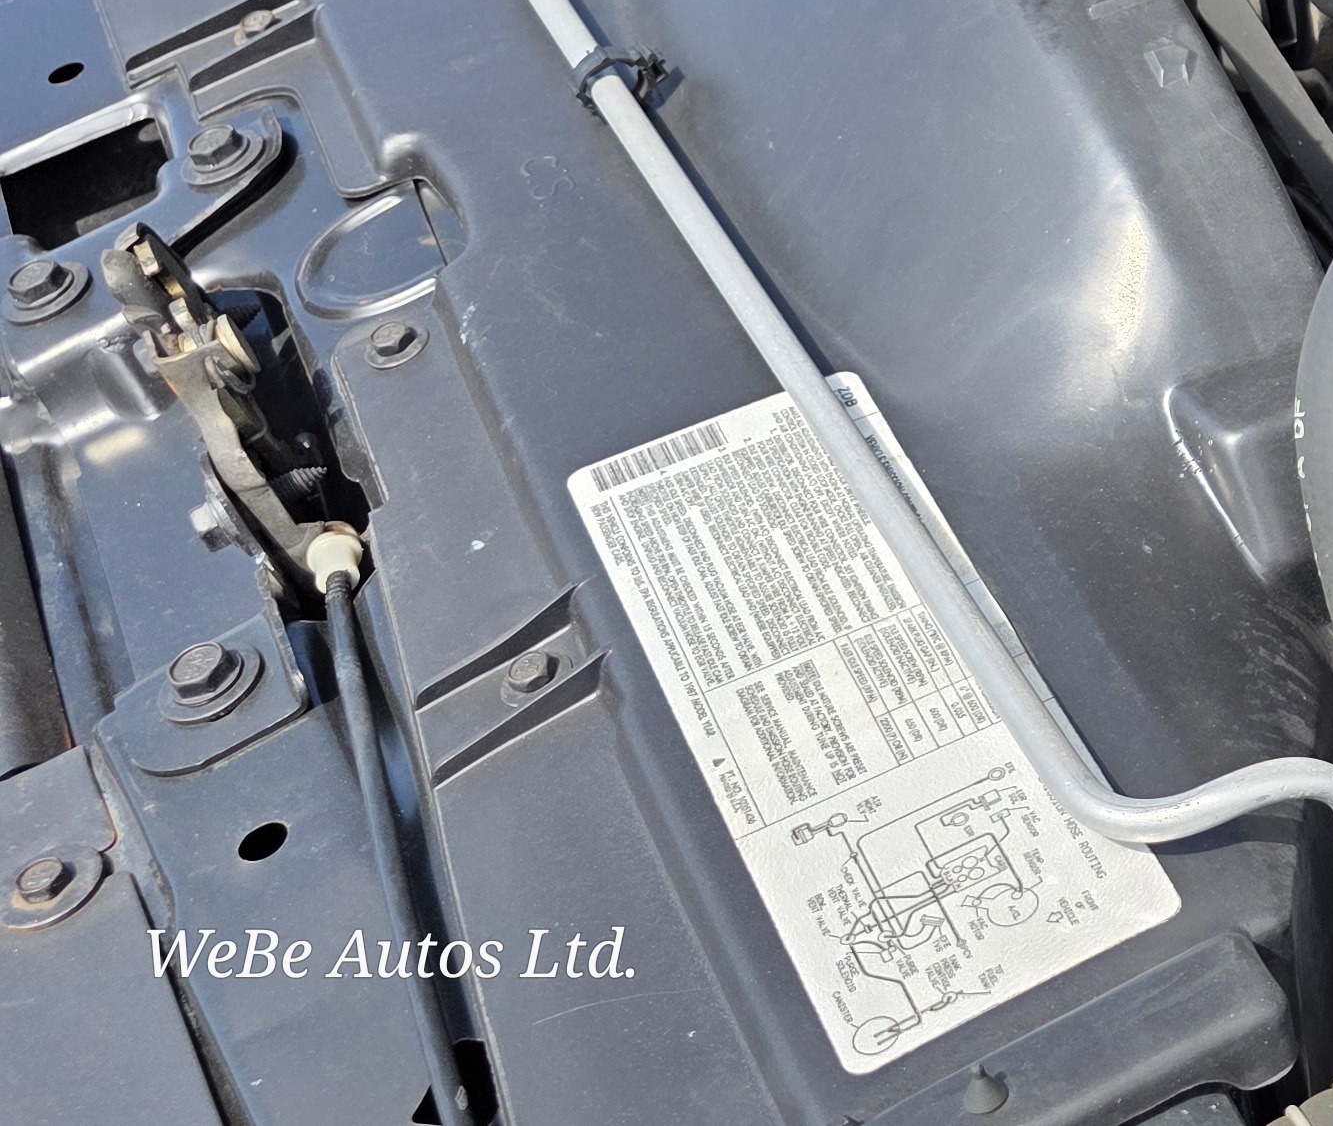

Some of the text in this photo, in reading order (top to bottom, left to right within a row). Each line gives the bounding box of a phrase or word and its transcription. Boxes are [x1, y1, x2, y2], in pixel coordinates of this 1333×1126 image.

[835, 384, 859, 408] ZDB
[1061, 816, 1108, 880] HOSE ROUTING
